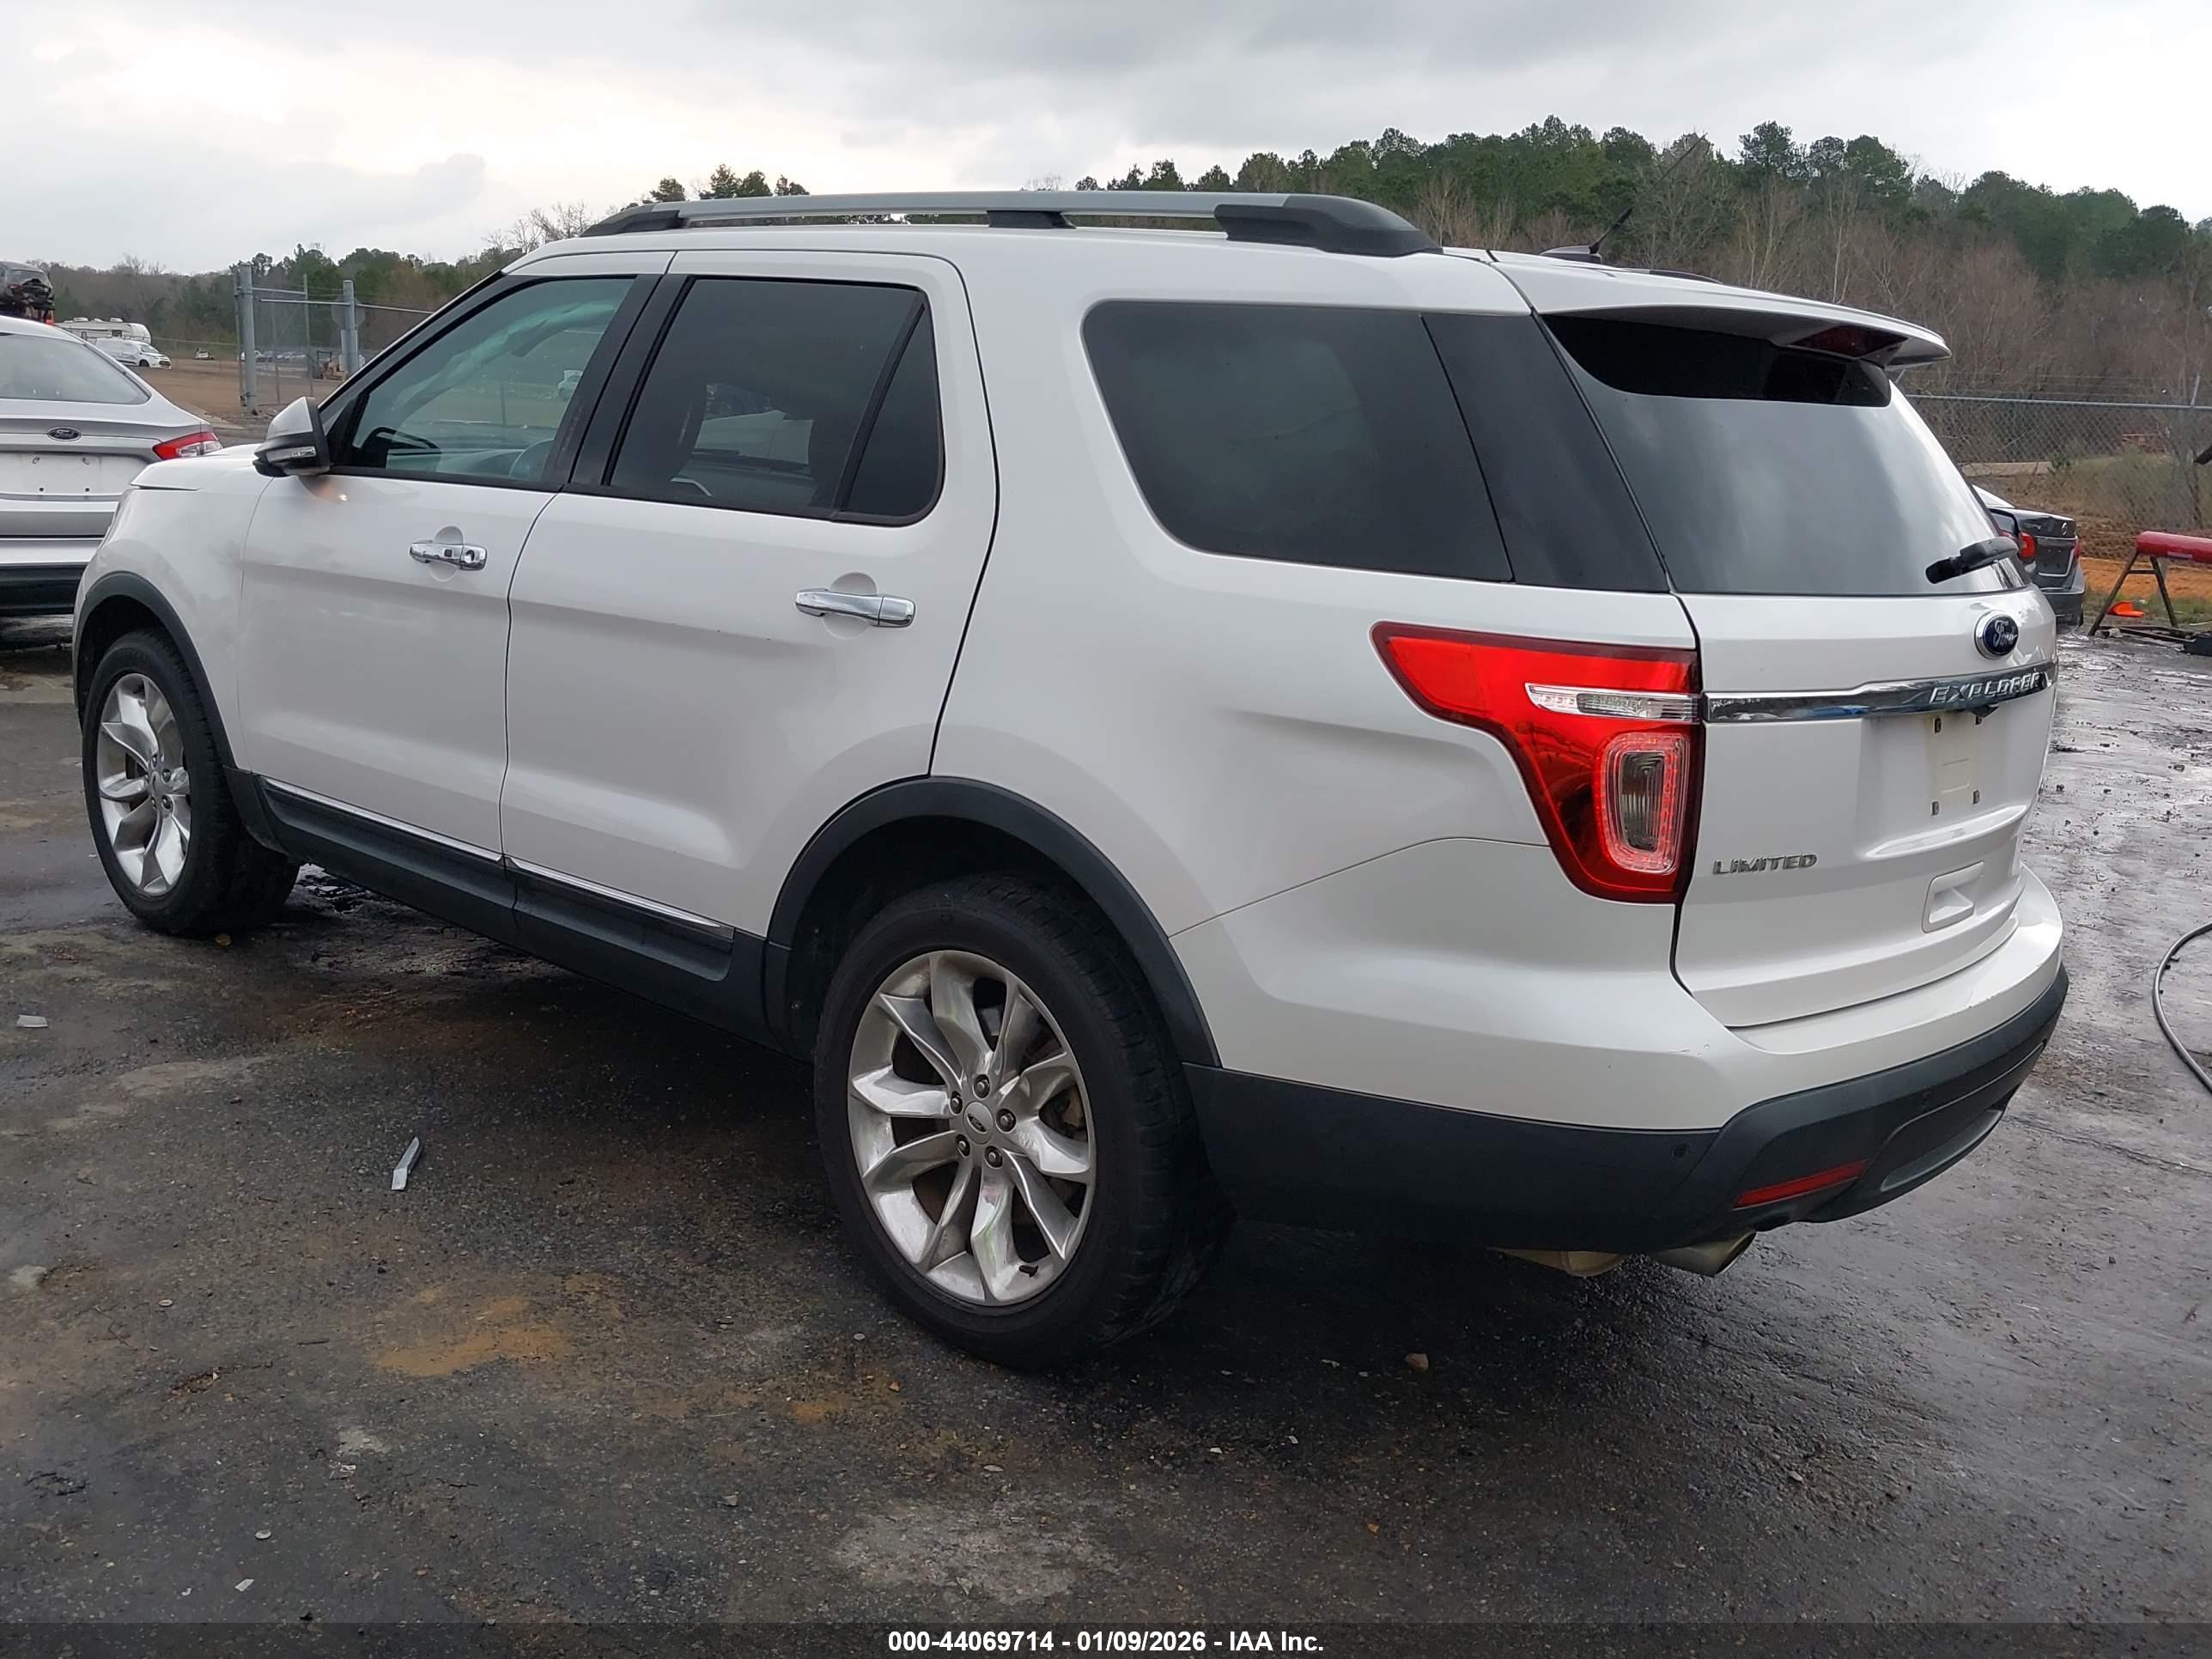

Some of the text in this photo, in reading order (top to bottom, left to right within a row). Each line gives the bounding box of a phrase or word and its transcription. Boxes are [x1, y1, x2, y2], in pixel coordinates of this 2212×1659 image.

[1993, 620, 2018, 647] Ford
[1929, 671, 2041, 704] EXPLORER
[1712, 854, 1818, 875] LIMITED
